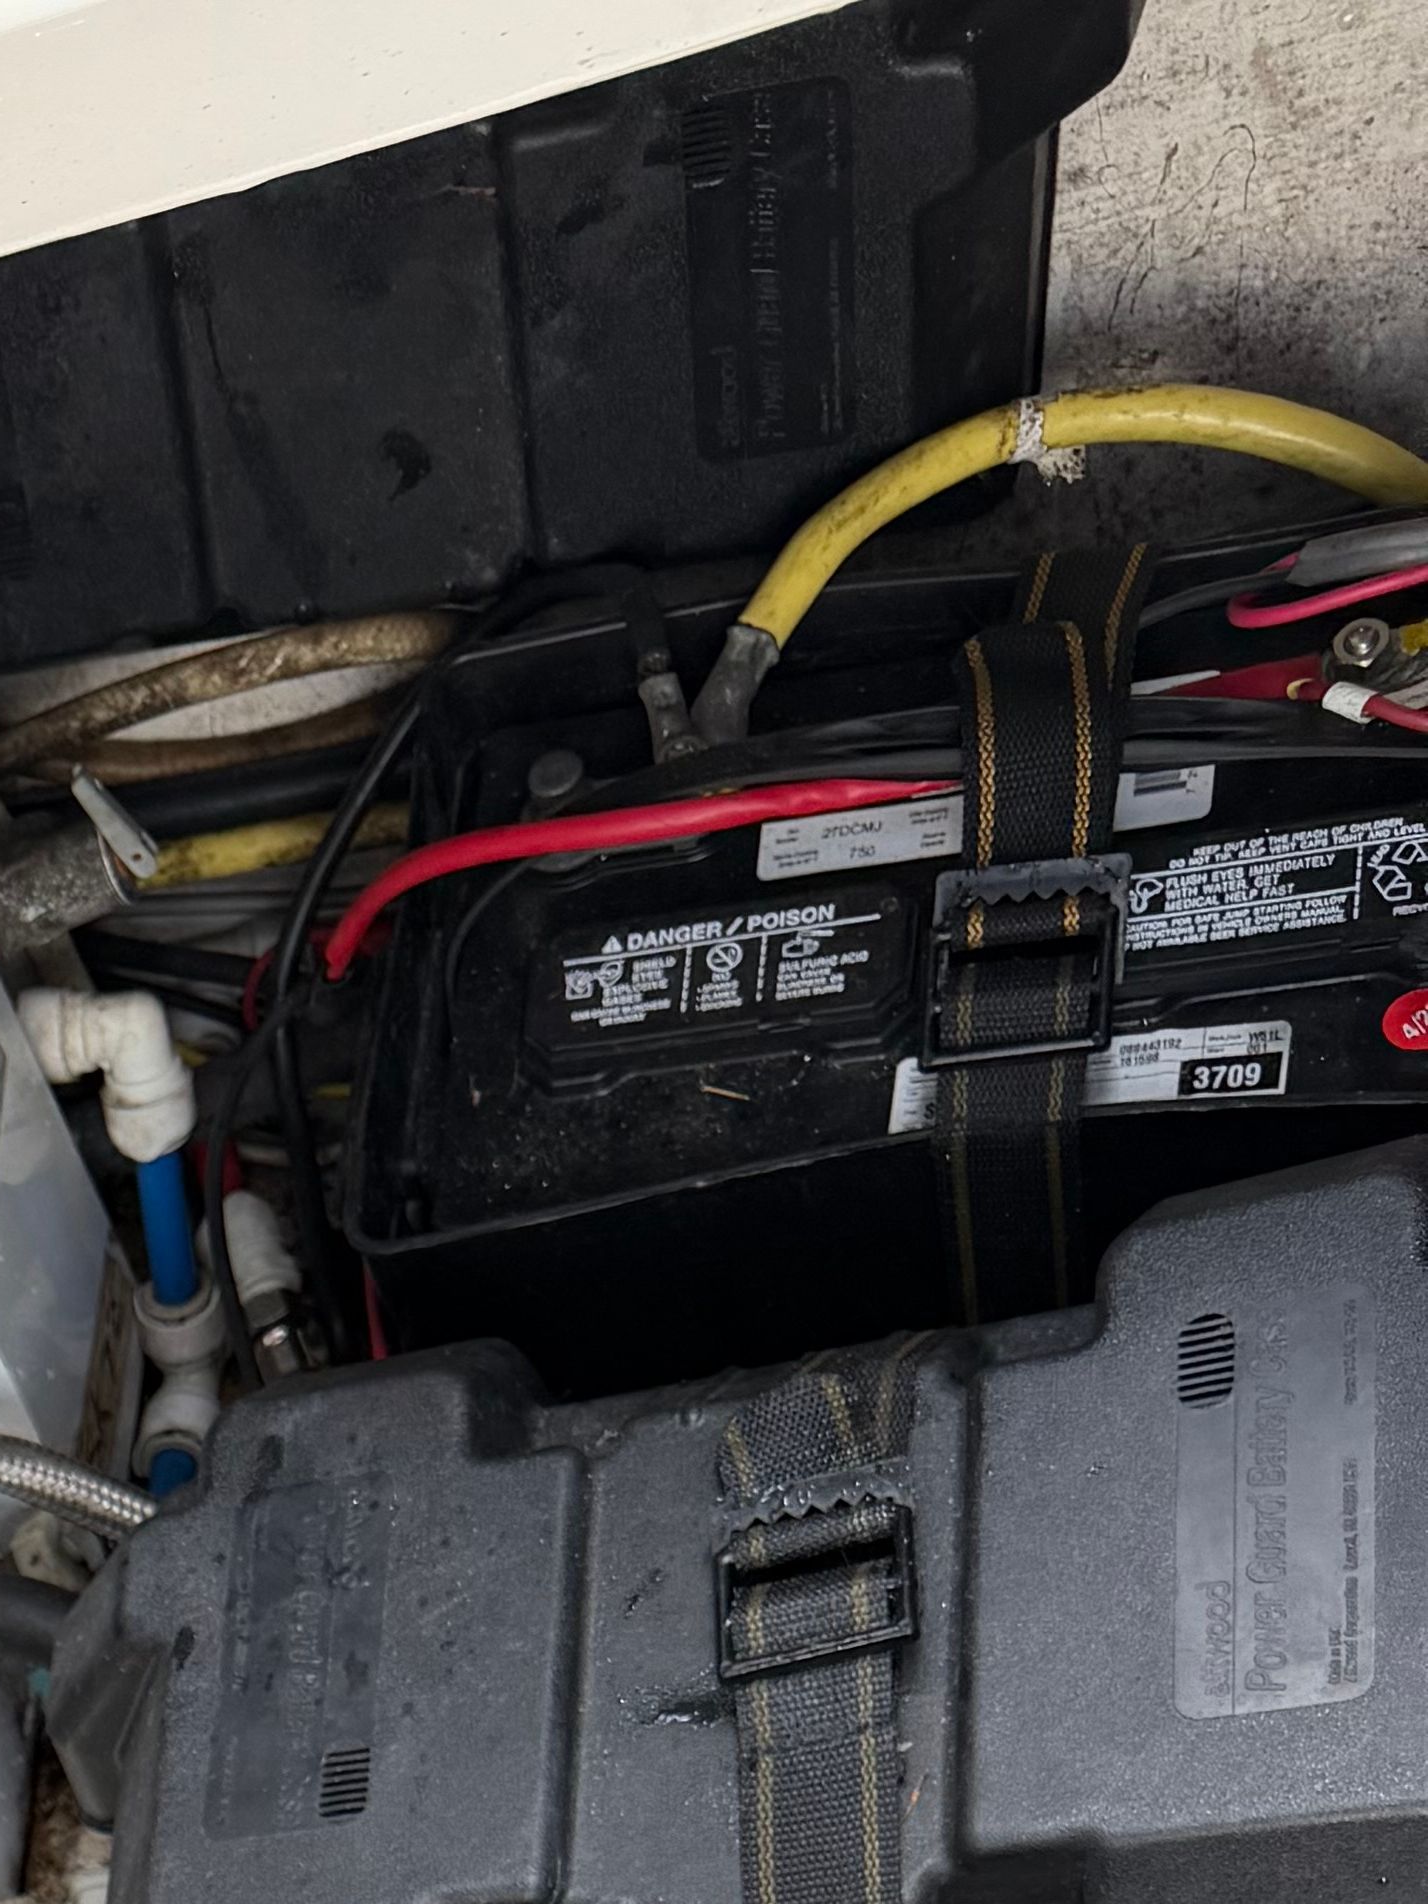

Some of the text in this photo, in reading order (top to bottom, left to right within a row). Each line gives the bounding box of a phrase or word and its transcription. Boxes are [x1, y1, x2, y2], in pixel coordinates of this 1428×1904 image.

[1165, 853, 1336, 889] FLUSH EYES IMMEDIATELY
[1165, 874, 1280, 900] WITH GET
[1163, 883, 1295, 912] MEDICAL HELP FAST
[624, 902, 837, 951] DANGER POISON
[1191, 1061, 1263, 1092] 3709
[1248, 1386, 1286, 1488] Battery
[1246, 1492, 1286, 1586] Guard
[1194, 1577, 1230, 1697] attwood
[1243, 1589, 1286, 1694] Power
